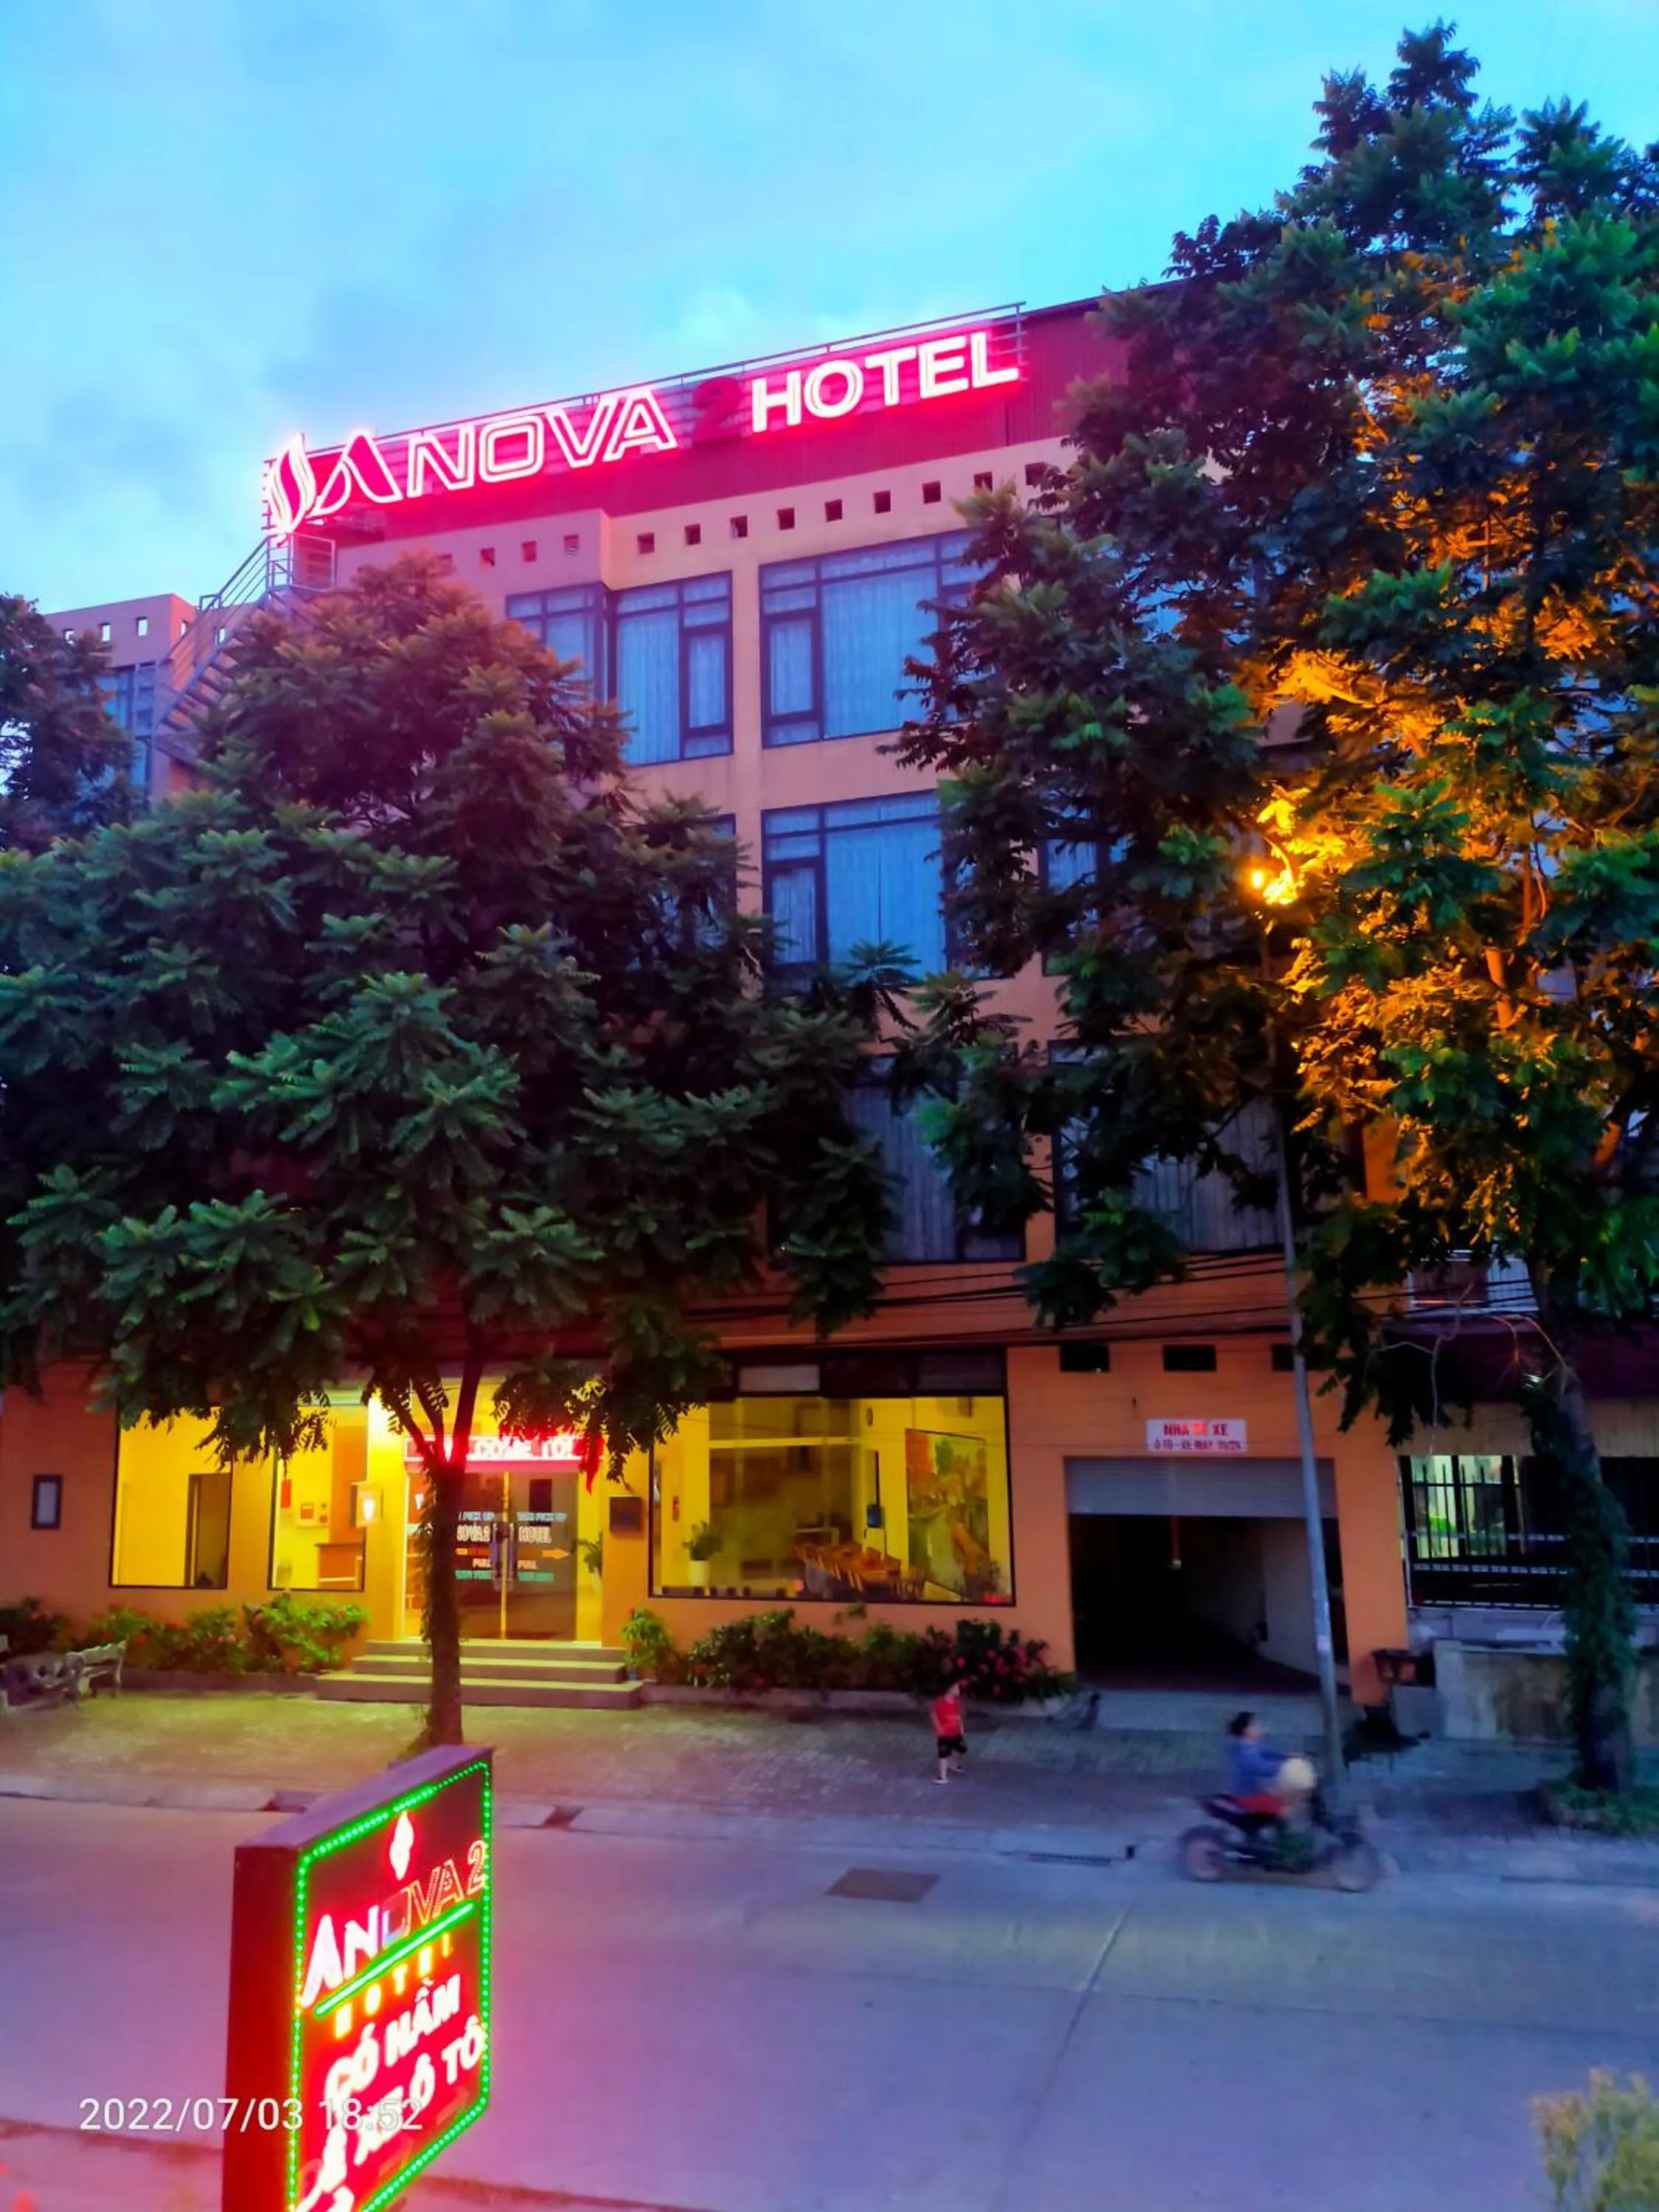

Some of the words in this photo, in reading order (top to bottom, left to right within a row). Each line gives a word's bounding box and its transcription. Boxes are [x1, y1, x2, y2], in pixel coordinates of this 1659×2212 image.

[308, 390, 678, 518] ANOVA
[751, 330, 1020, 434] HOTEL
[300, 1858, 465, 2008] ANOVA
[467, 1840, 490, 1896] 2
[441, 2014, 487, 2084] TÔ
